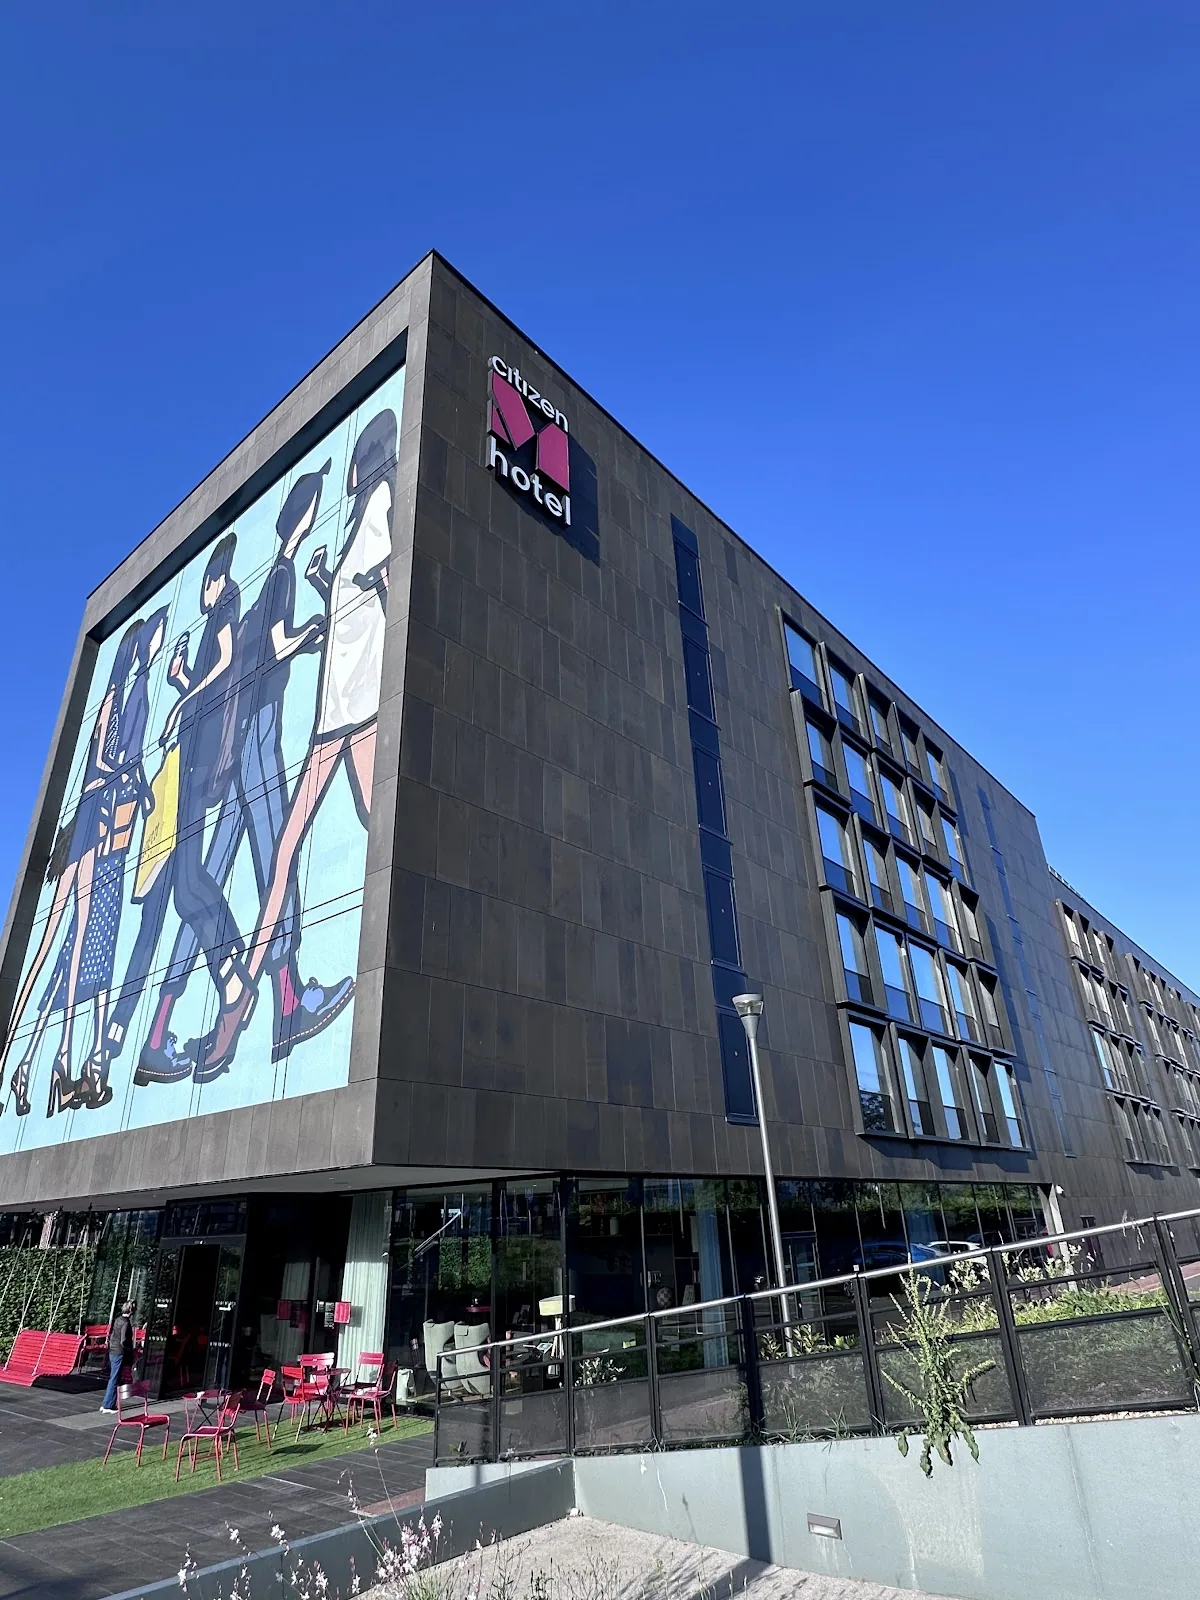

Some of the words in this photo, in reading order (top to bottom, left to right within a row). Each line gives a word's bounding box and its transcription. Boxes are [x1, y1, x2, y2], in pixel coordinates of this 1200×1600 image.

[490, 355, 569, 432] citizen
[490, 370, 570, 493] M
[489, 435, 571, 526] hotel
